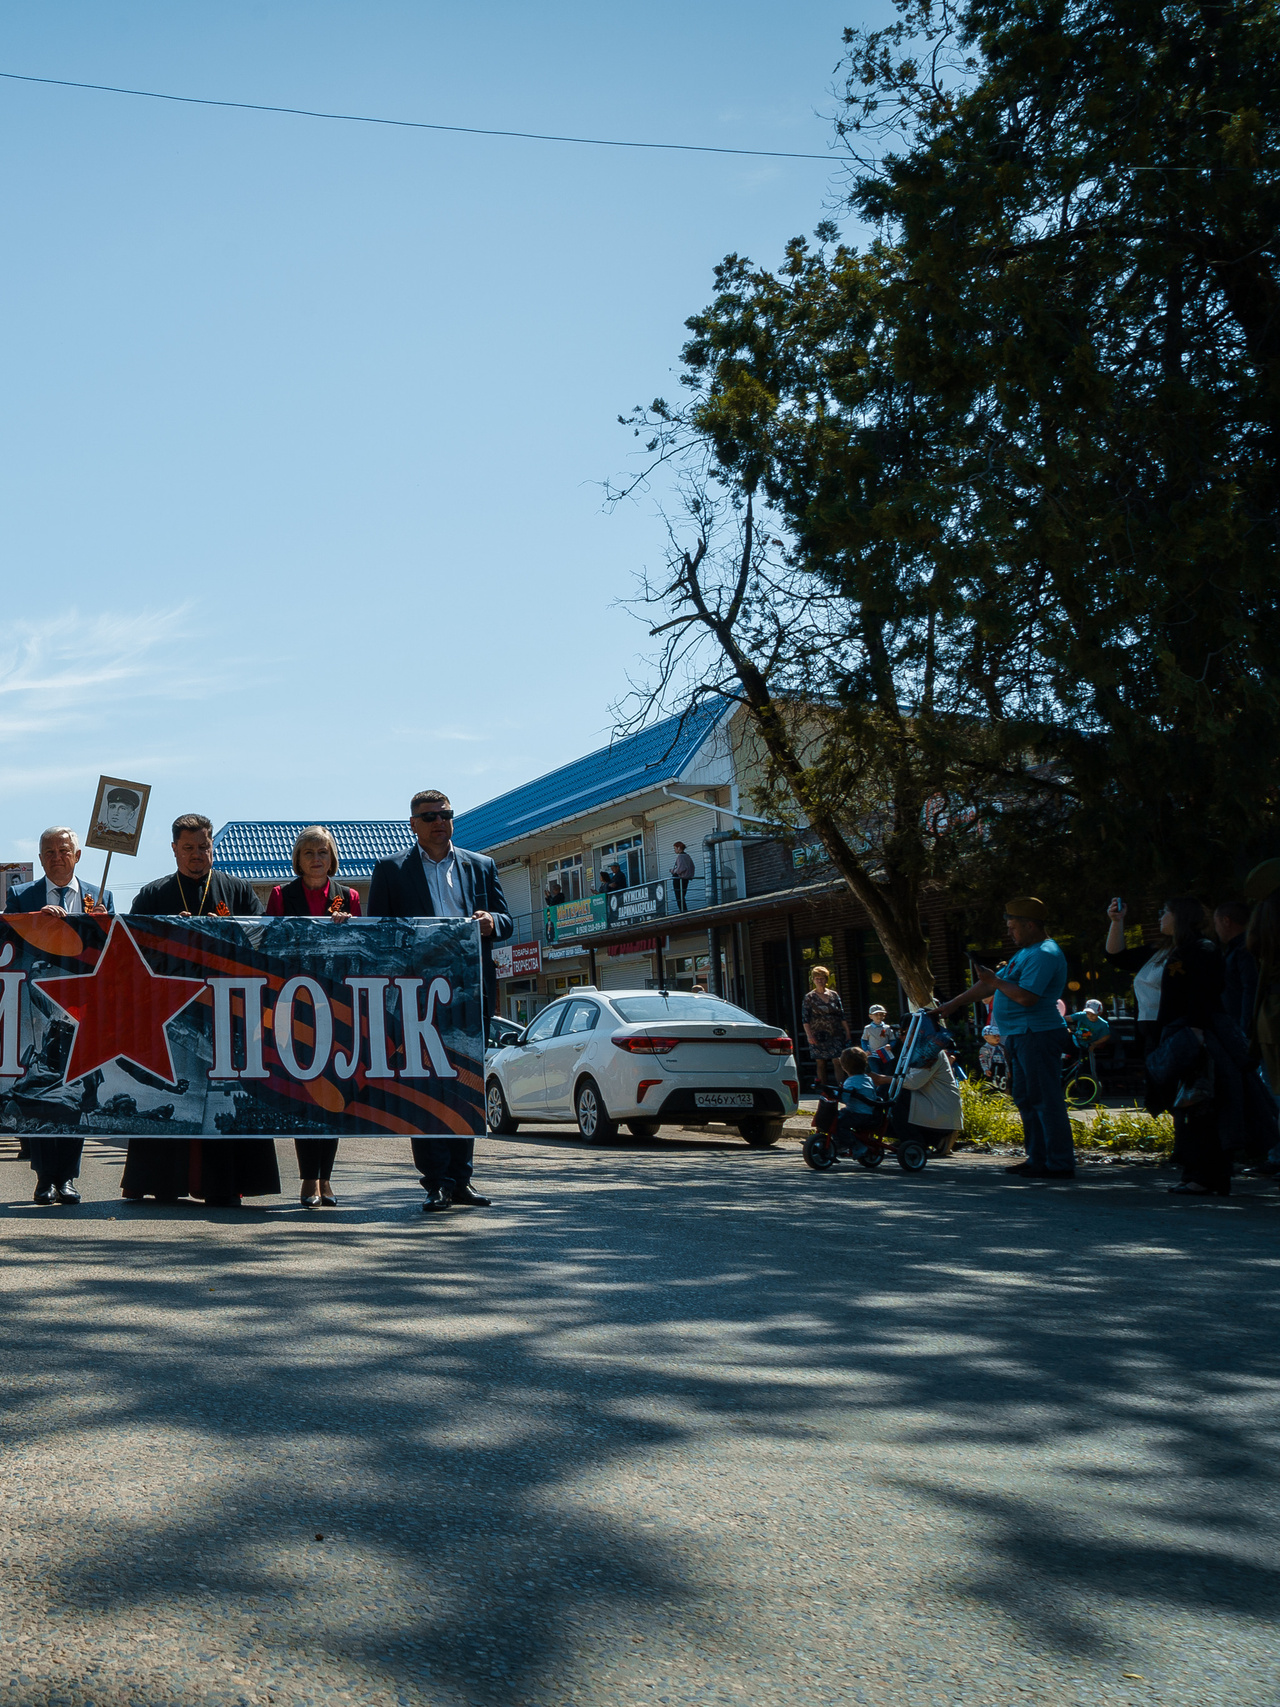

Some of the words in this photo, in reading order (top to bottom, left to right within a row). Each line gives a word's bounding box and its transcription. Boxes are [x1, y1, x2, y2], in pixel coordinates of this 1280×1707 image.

[622, 887, 649, 903] МУЖСКАЯ
[556, 899, 592, 920] ИНТЕРНЕТ
[512, 947, 529, 957] ТОВАРЫ
[513, 957, 539, 972] ТВОРЧЕСТВА
[206, 976, 458, 1081] ПОЛК
